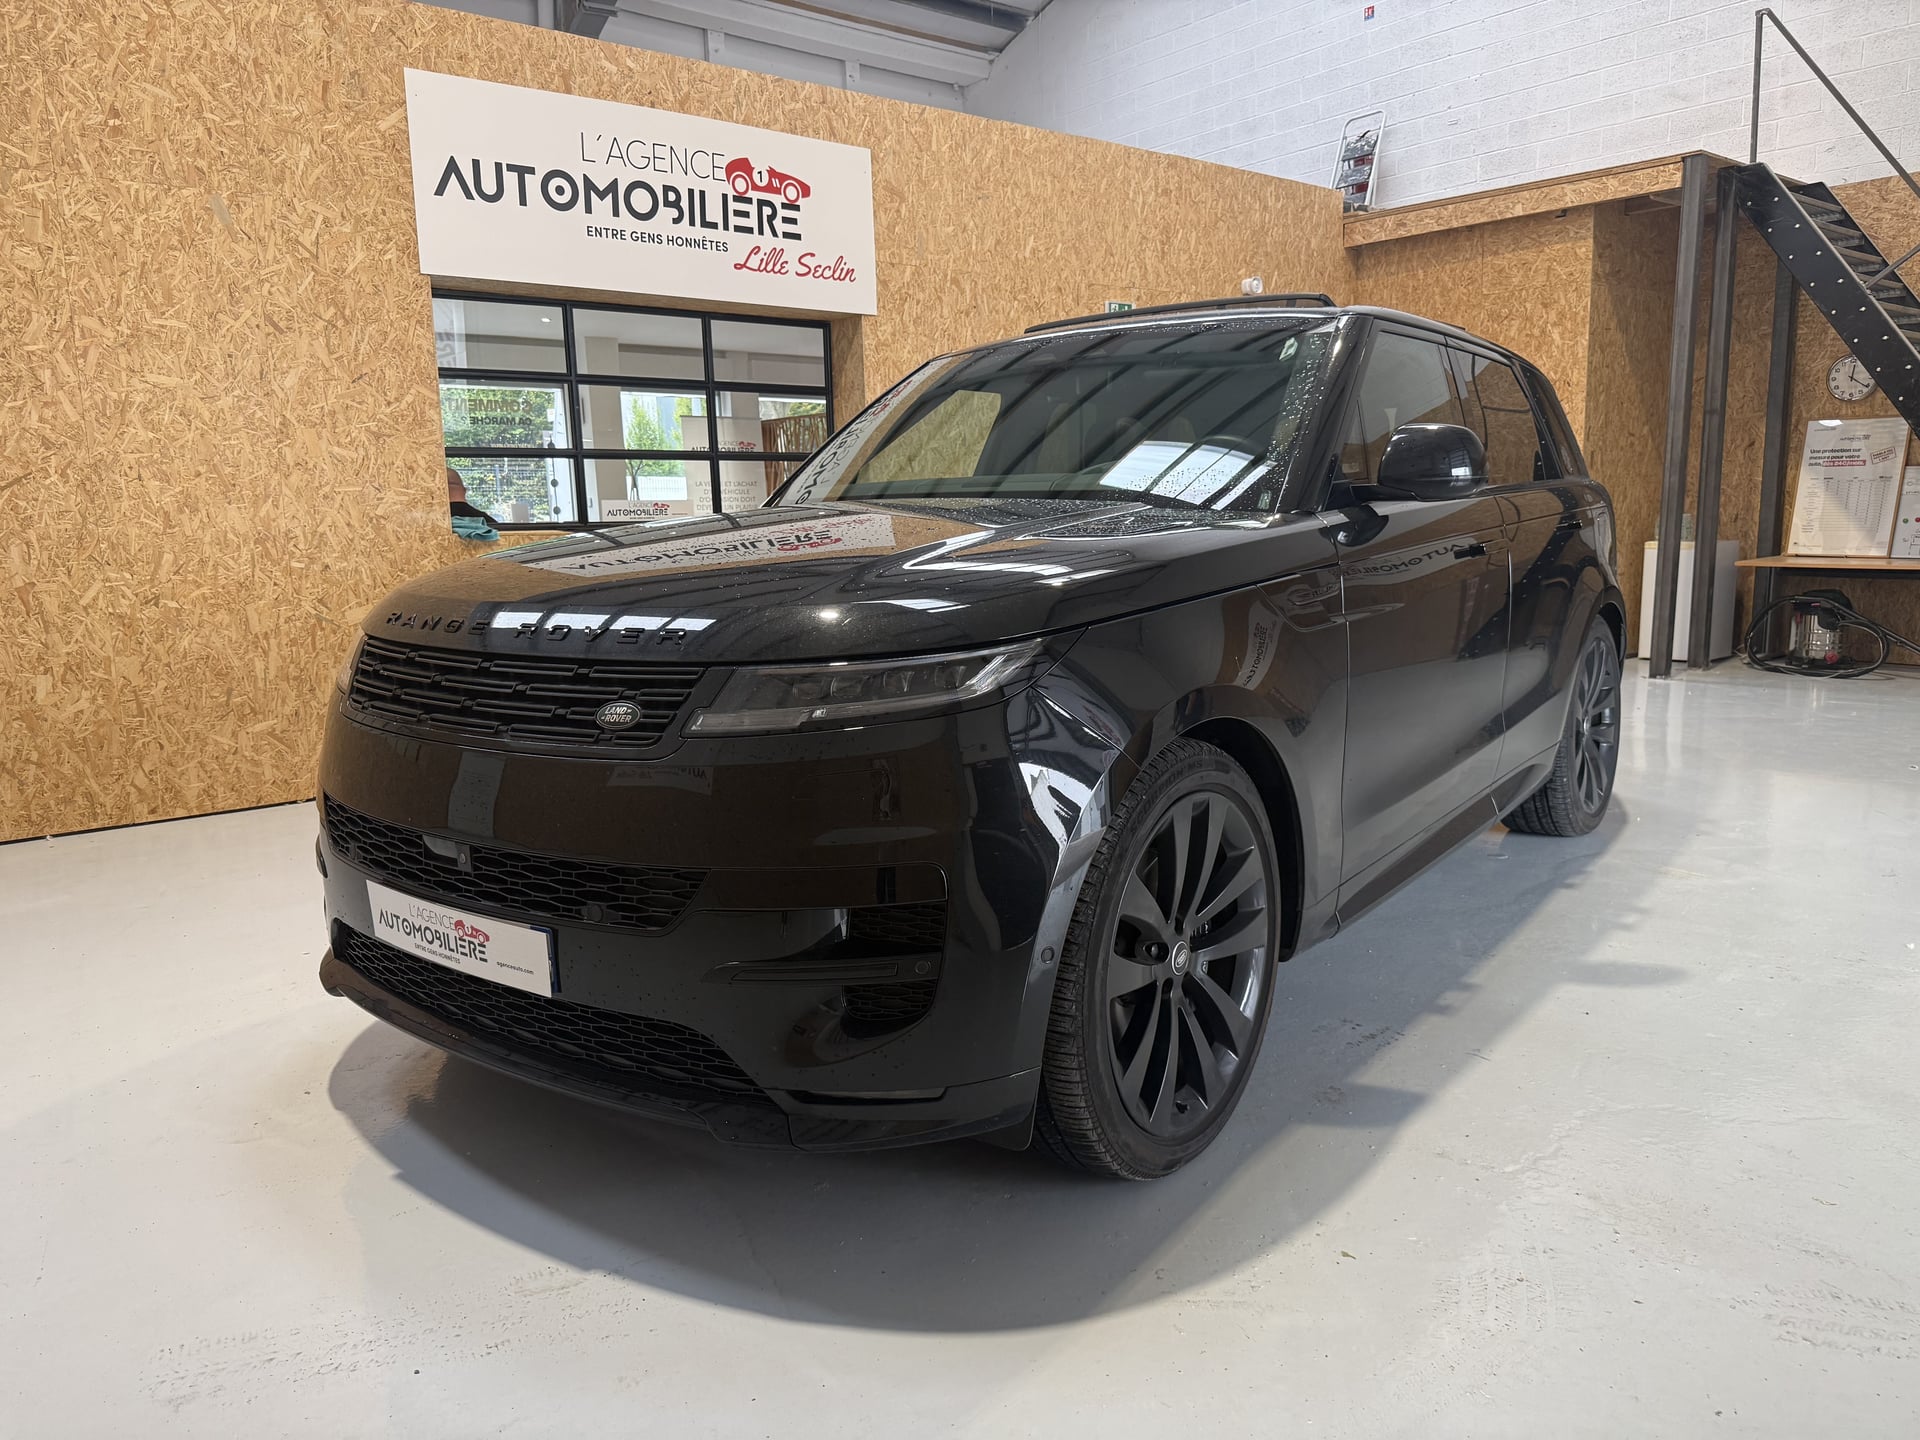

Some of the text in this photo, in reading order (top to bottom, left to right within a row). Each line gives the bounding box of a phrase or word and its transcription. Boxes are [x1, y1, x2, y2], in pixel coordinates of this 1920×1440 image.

[580, 131, 726, 182] L'AGENCE
[586, 226, 729, 253] ENTRE GENS HONNÊTES
[733, 245, 857, 283] Lille Seclin
[385, 610, 687, 646] RANGE ROVER
[604, 706, 628, 714] LAND
[604, 714, 632, 722] ROVER
[408, 903, 455, 930] L'AGENCE
